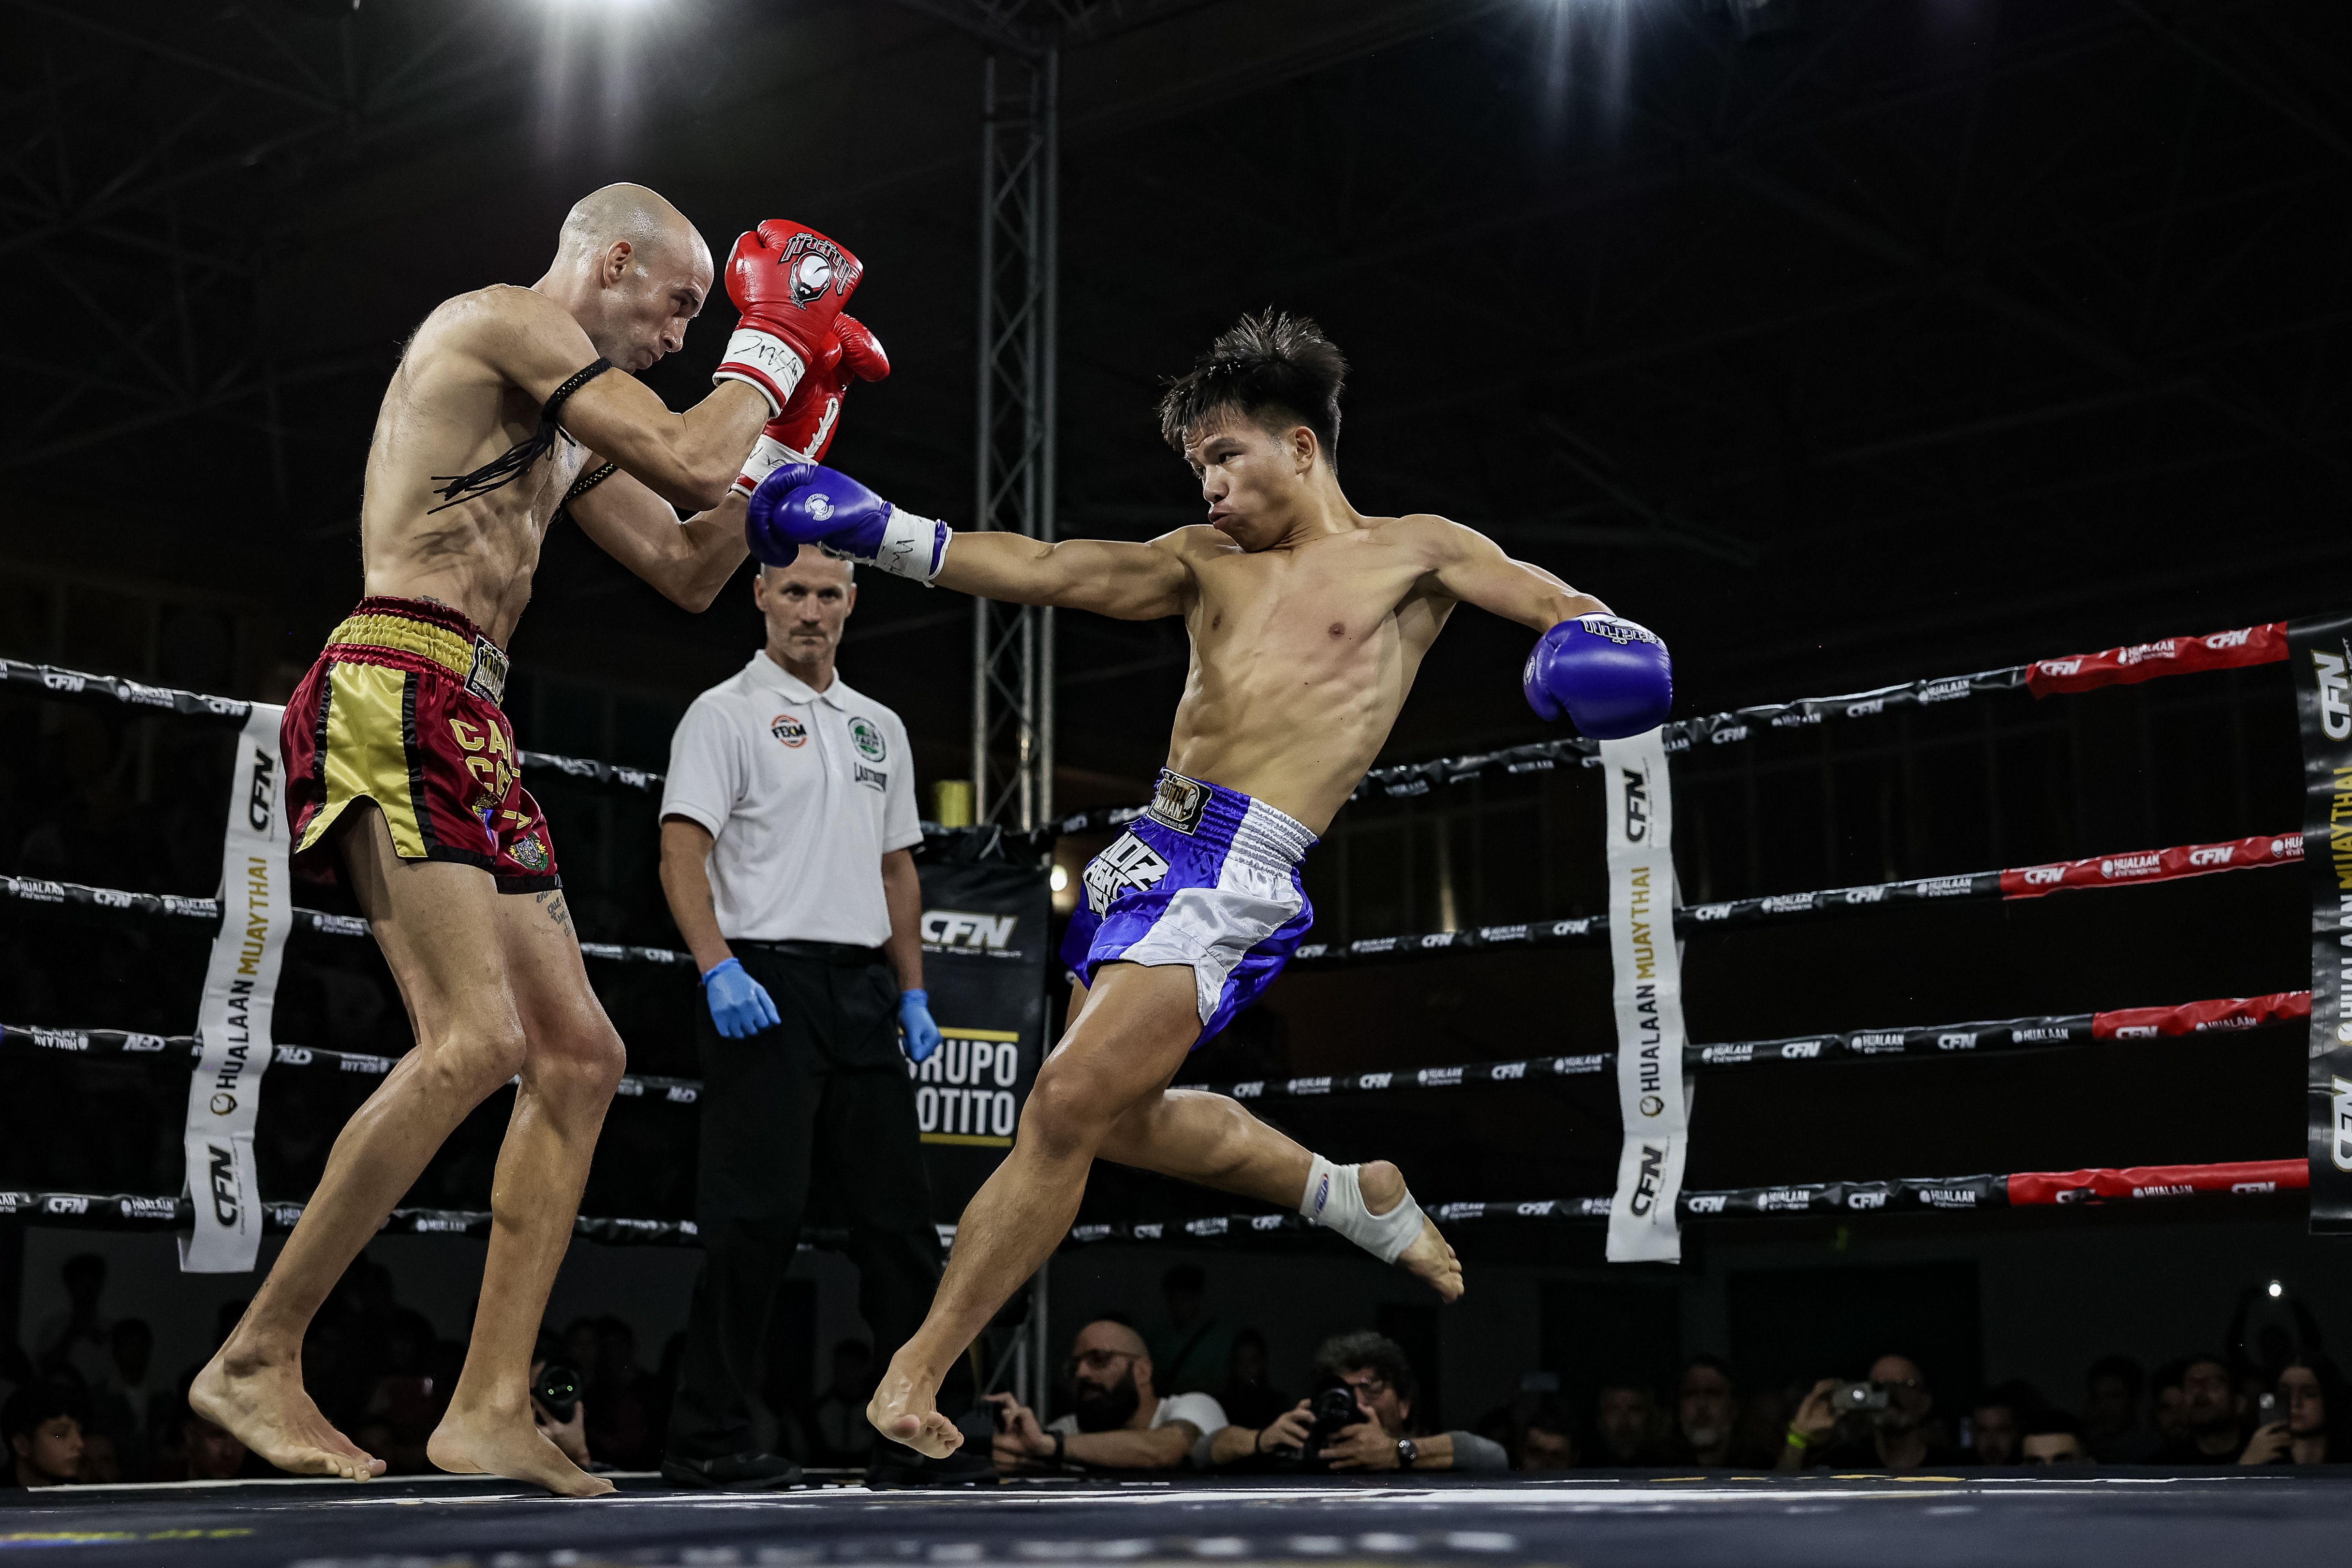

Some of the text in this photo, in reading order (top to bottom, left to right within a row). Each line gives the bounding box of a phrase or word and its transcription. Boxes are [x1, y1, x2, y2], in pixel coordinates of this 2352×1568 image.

[2206, 627, 2252, 649] CFN
[2040, 659, 2082, 676] CFN
[44, 673, 85, 693] CFN
[2313, 651, 2352, 740] CFN
[250, 749, 275, 832] CFN
[1623, 767, 1648, 843] CFN
[2189, 846, 2234, 866] CFN
[2024, 867, 2067, 885] CFN
[93, 891, 132, 908] CFN
[1846, 887, 1885, 904] CFN
[1695, 903, 1732, 920] CFN
[920, 909, 1017, 949] CFN
[216, 979, 254, 1090] HUALAAN
[1636, 984, 1661, 1092] HUALAAN
[1938, 1033, 1979, 1050] CFN
[1781, 1041, 1822, 1059] CFN
[905, 1039, 1018, 1087] RUPO
[917, 1086, 1015, 1137] OTITO
[2334, 1076, 2352, 1170] CFN
[208, 1144, 237, 1227] CFN
[1630, 1144, 1664, 1218] CFN
[1688, 1195, 1727, 1213] CFN
[1848, 1192, 1886, 1209] CFN
